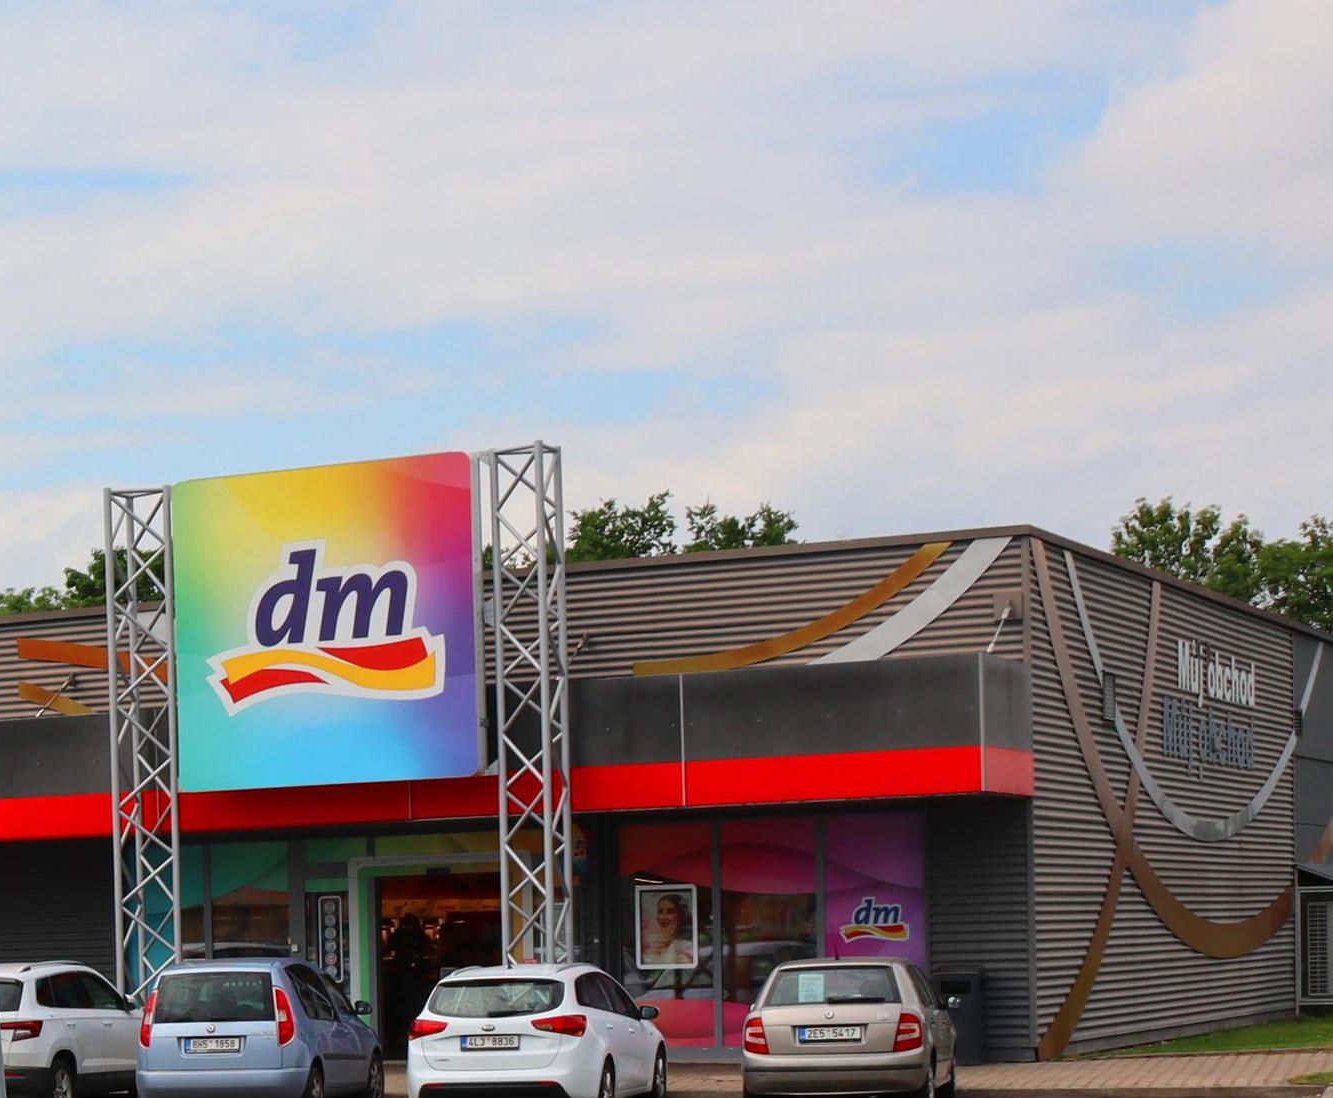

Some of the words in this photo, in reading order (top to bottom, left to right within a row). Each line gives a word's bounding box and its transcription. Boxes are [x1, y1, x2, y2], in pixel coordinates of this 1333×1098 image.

[255, 548, 408, 647] dm
[1177, 639, 1204, 708] Můj
[1207, 651, 1255, 708] obchod
[853, 898, 901, 925] dm
[468, 1037, 485, 1047] 4L3
[807, 1028, 824, 1039] 2E5
[832, 1028, 856, 1038] 5417
